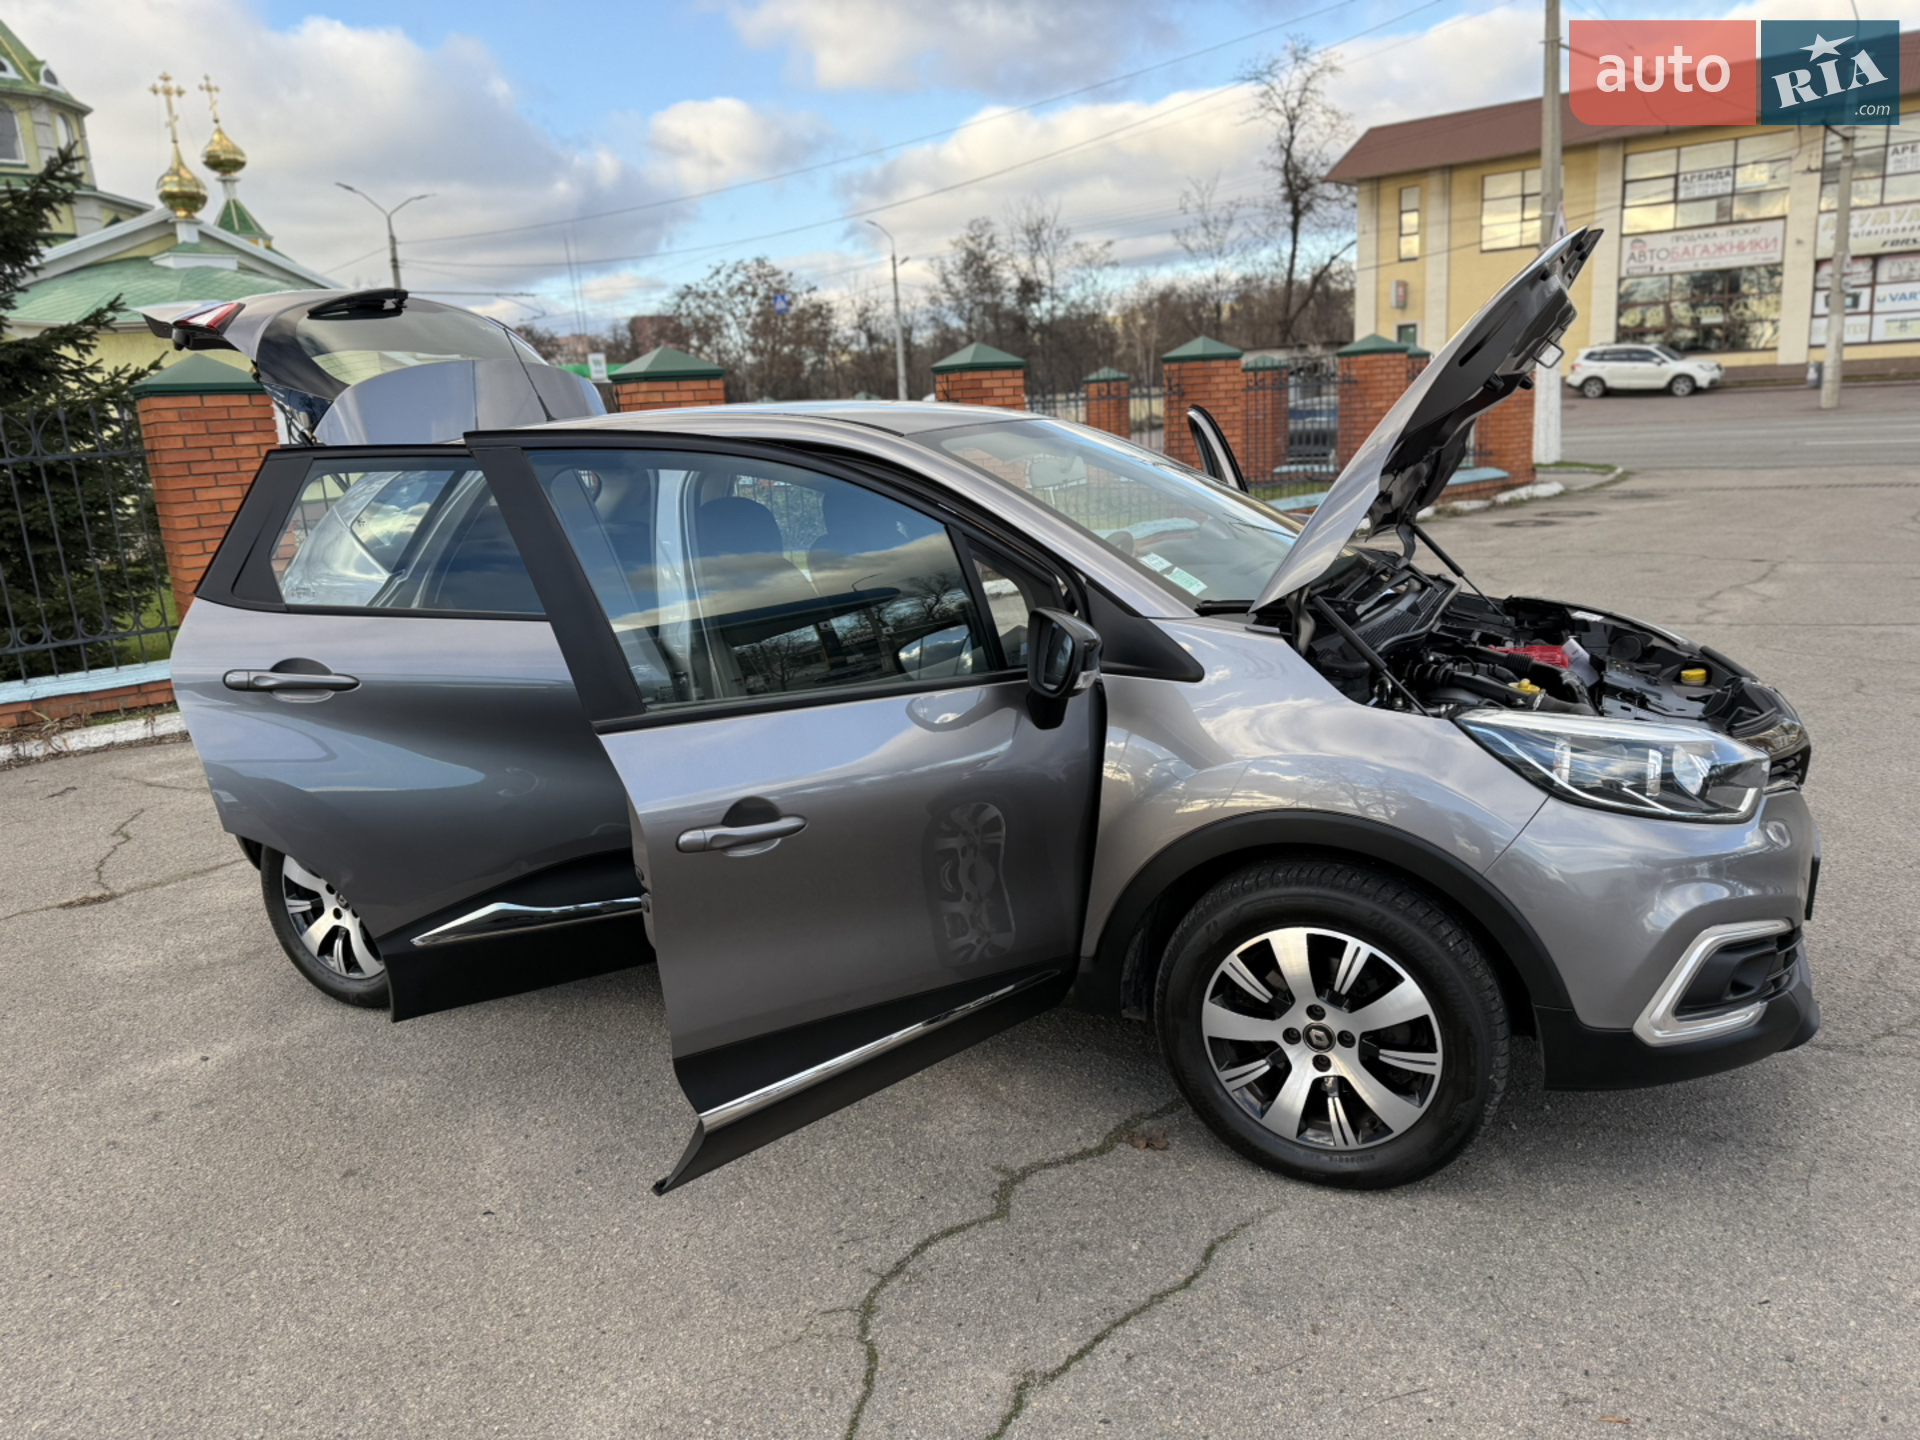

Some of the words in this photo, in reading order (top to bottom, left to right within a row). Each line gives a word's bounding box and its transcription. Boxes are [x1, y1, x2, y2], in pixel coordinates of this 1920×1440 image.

[1682, 169, 1733, 183] АРЕНДА
[1671, 231, 1718, 244] ПРОДАЖА
[1726, 226, 1762, 238] ПРОКАТ
[1626, 236, 1779, 265] АВТОБАГАЖНИКИ
[1888, 290, 1920, 303] VAR
